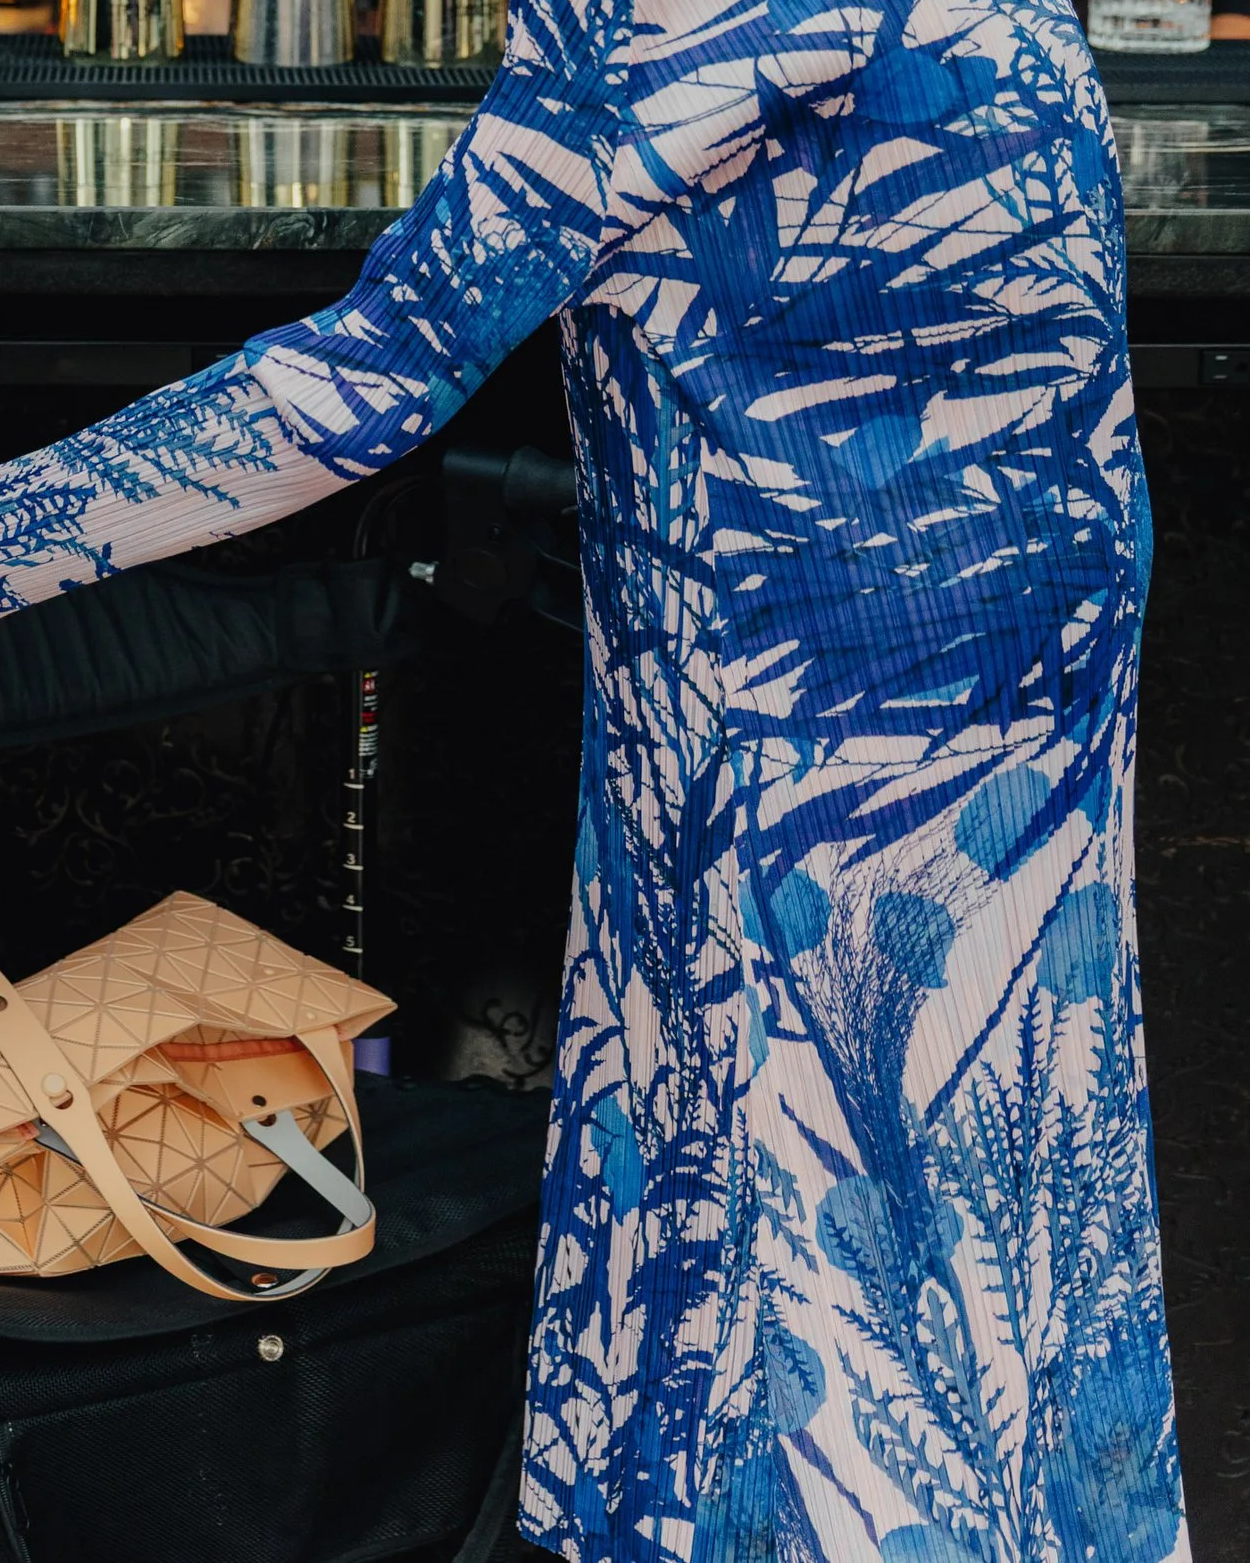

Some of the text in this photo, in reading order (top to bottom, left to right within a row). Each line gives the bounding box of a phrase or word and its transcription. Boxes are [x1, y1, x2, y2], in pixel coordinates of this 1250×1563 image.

[348, 768, 355, 779] 1
[347, 811, 356, 823] 2
[346, 853, 356, 865] 3
[346, 894, 355, 905] 4
[346, 936, 355, 947] 5
